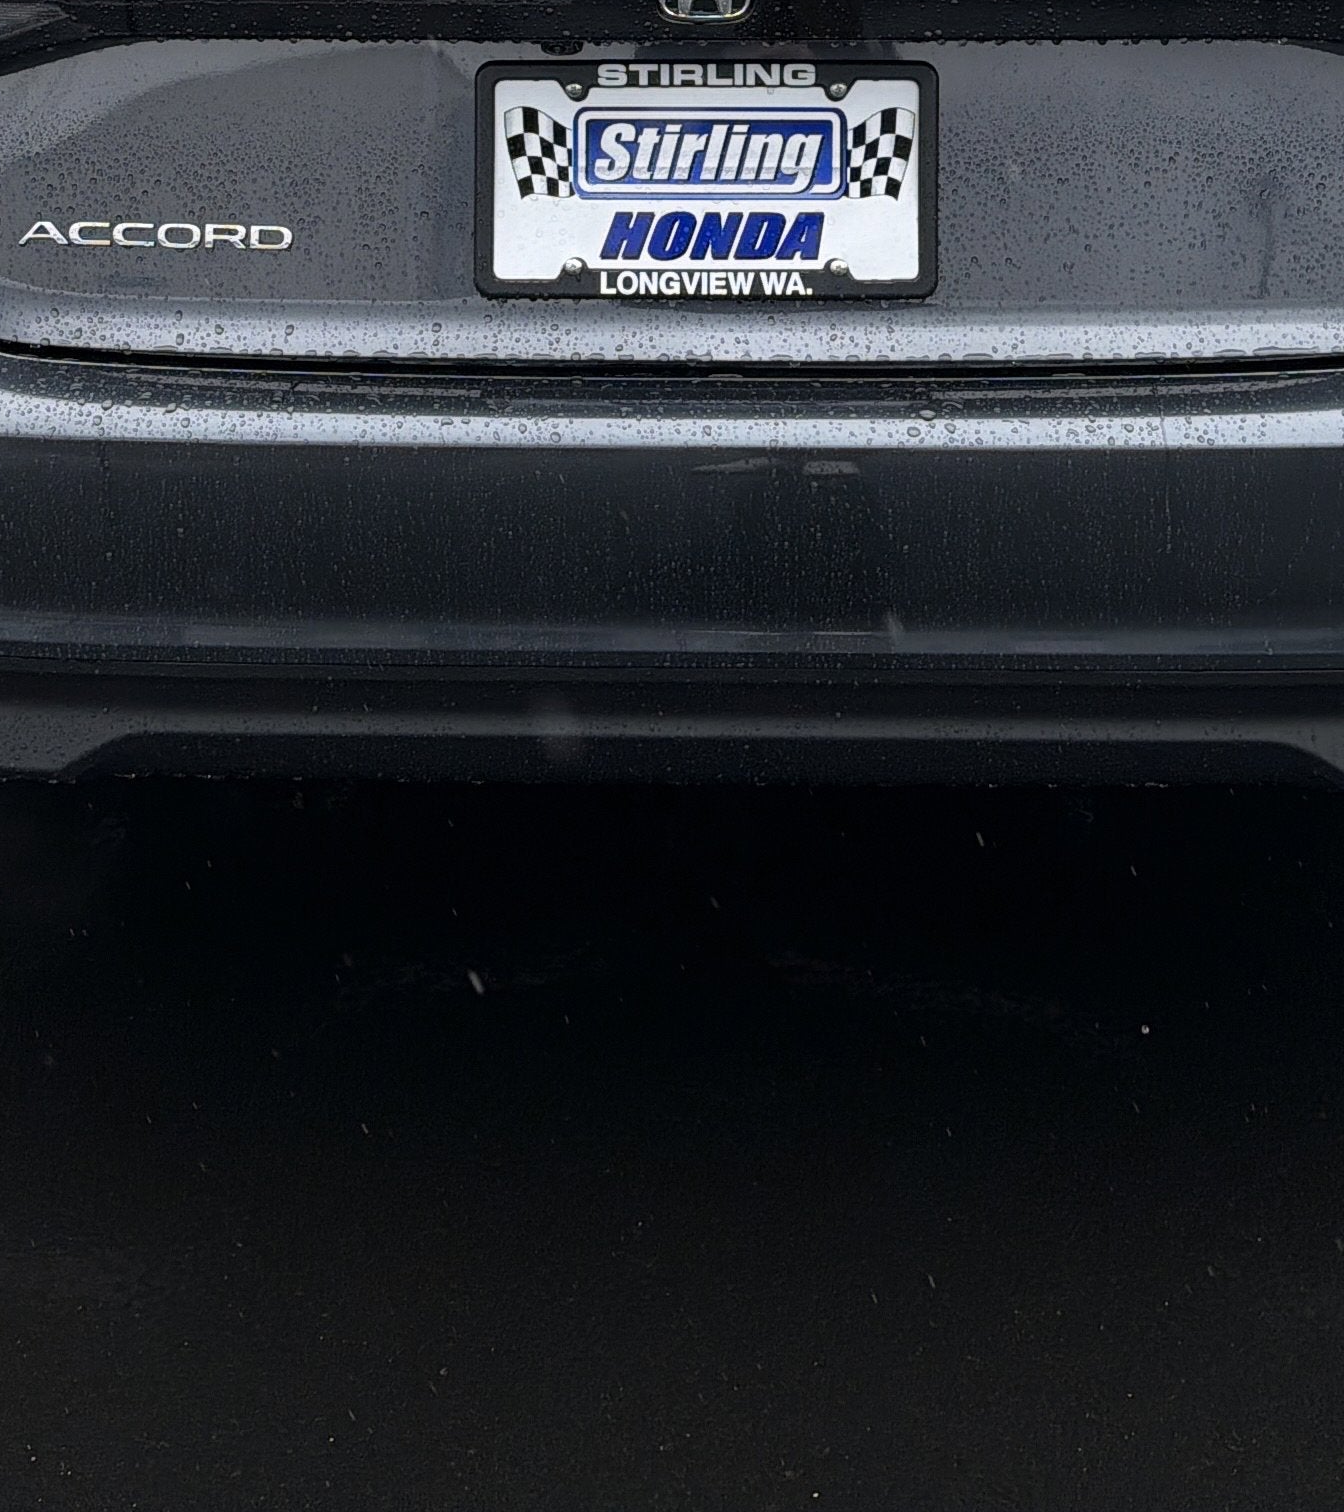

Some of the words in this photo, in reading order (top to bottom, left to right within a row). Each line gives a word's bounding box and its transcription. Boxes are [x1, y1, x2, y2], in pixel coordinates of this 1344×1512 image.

[597, 63, 816, 87] STIRLING
[593, 121, 824, 193] Stirling
[18, 221, 293, 250] ACCORD
[599, 211, 825, 261] HONDA
[599, 272, 754, 296] LONGVIEW
[760, 272, 813, 296] WA.
